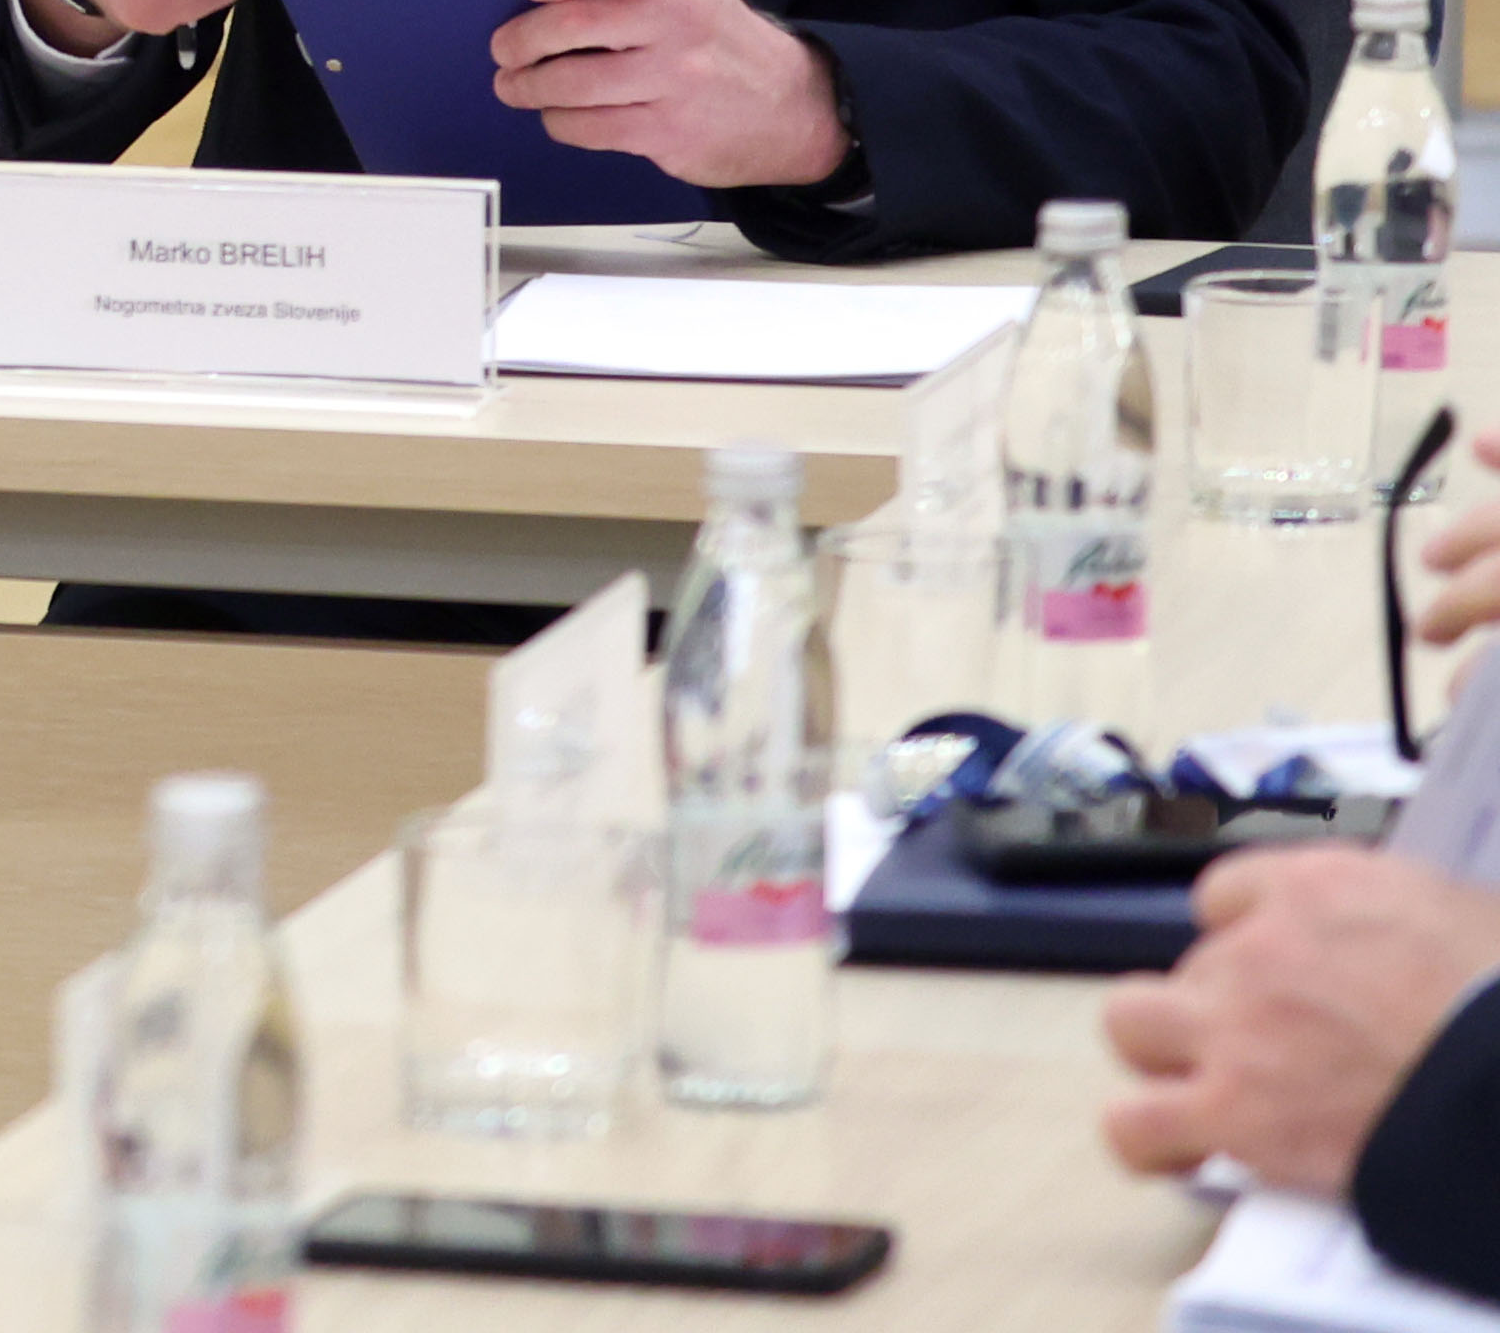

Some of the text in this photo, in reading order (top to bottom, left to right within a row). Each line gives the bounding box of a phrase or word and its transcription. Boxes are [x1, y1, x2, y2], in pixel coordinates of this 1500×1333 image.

[128, 239, 326, 268] Marko BRELIH
[94, 294, 362, 325] Nogometna zveza Slovenije
